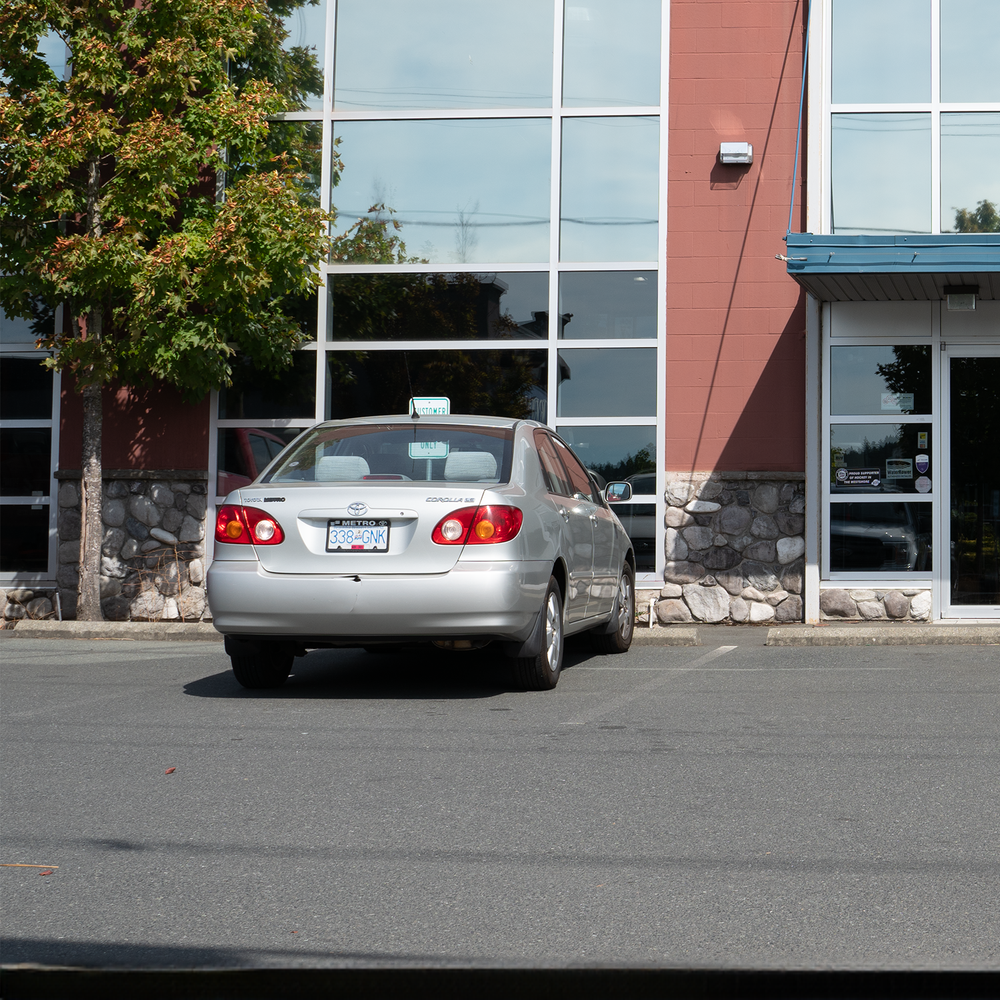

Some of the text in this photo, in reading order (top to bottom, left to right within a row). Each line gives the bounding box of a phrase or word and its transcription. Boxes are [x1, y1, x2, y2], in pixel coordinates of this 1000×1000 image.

[414, 407, 447, 415] USTOMER
[330, 529, 386, 544] 338 GNK
